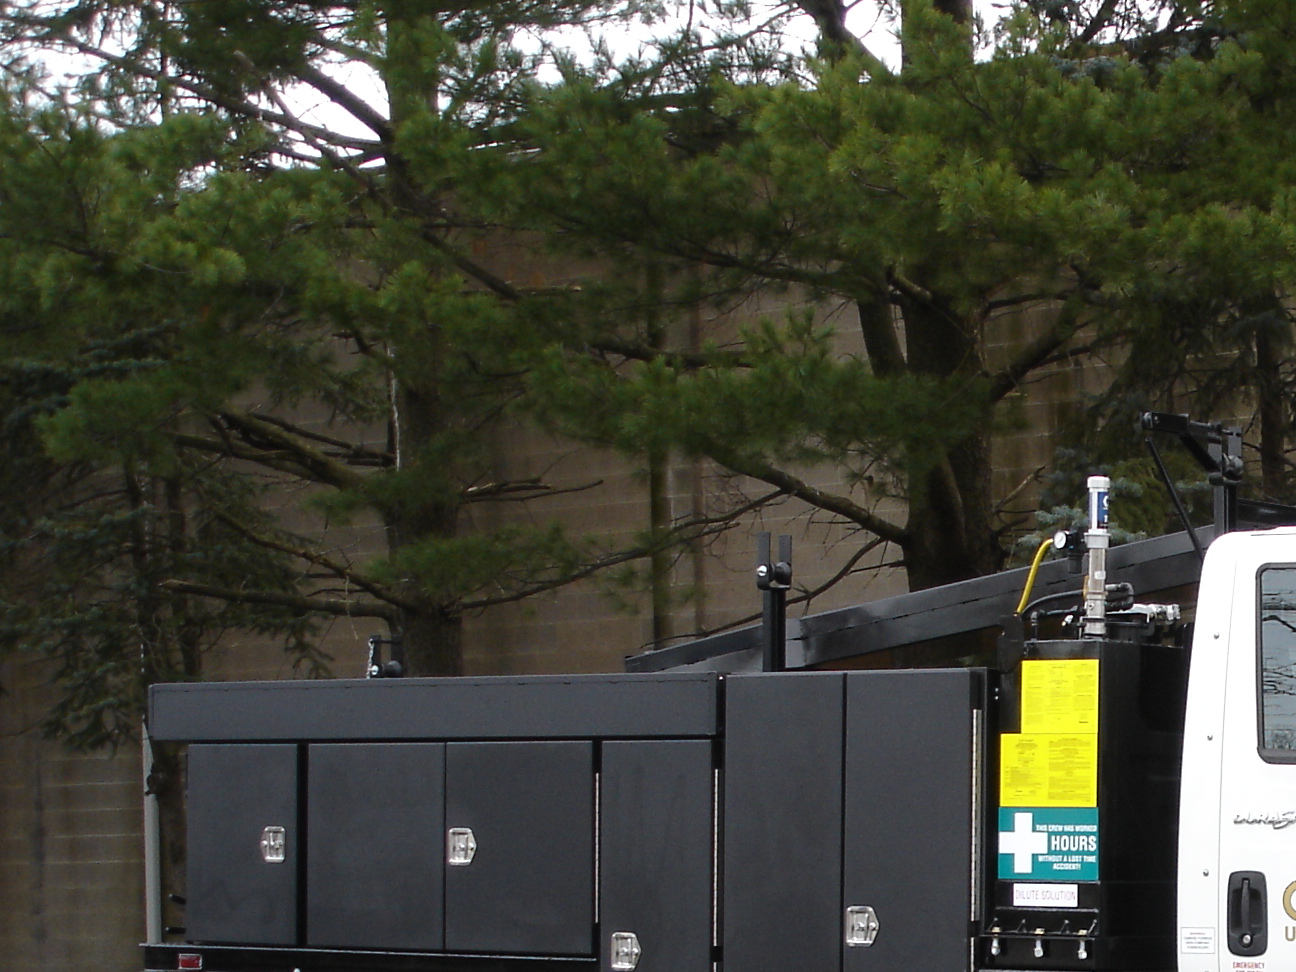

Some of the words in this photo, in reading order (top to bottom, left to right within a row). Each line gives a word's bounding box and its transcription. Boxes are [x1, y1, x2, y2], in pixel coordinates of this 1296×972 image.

[1051, 835, 1097, 851] HOURS
[1015, 889, 1039, 900] DILUTE
[1041, 889, 1075, 901] SOLUTION
